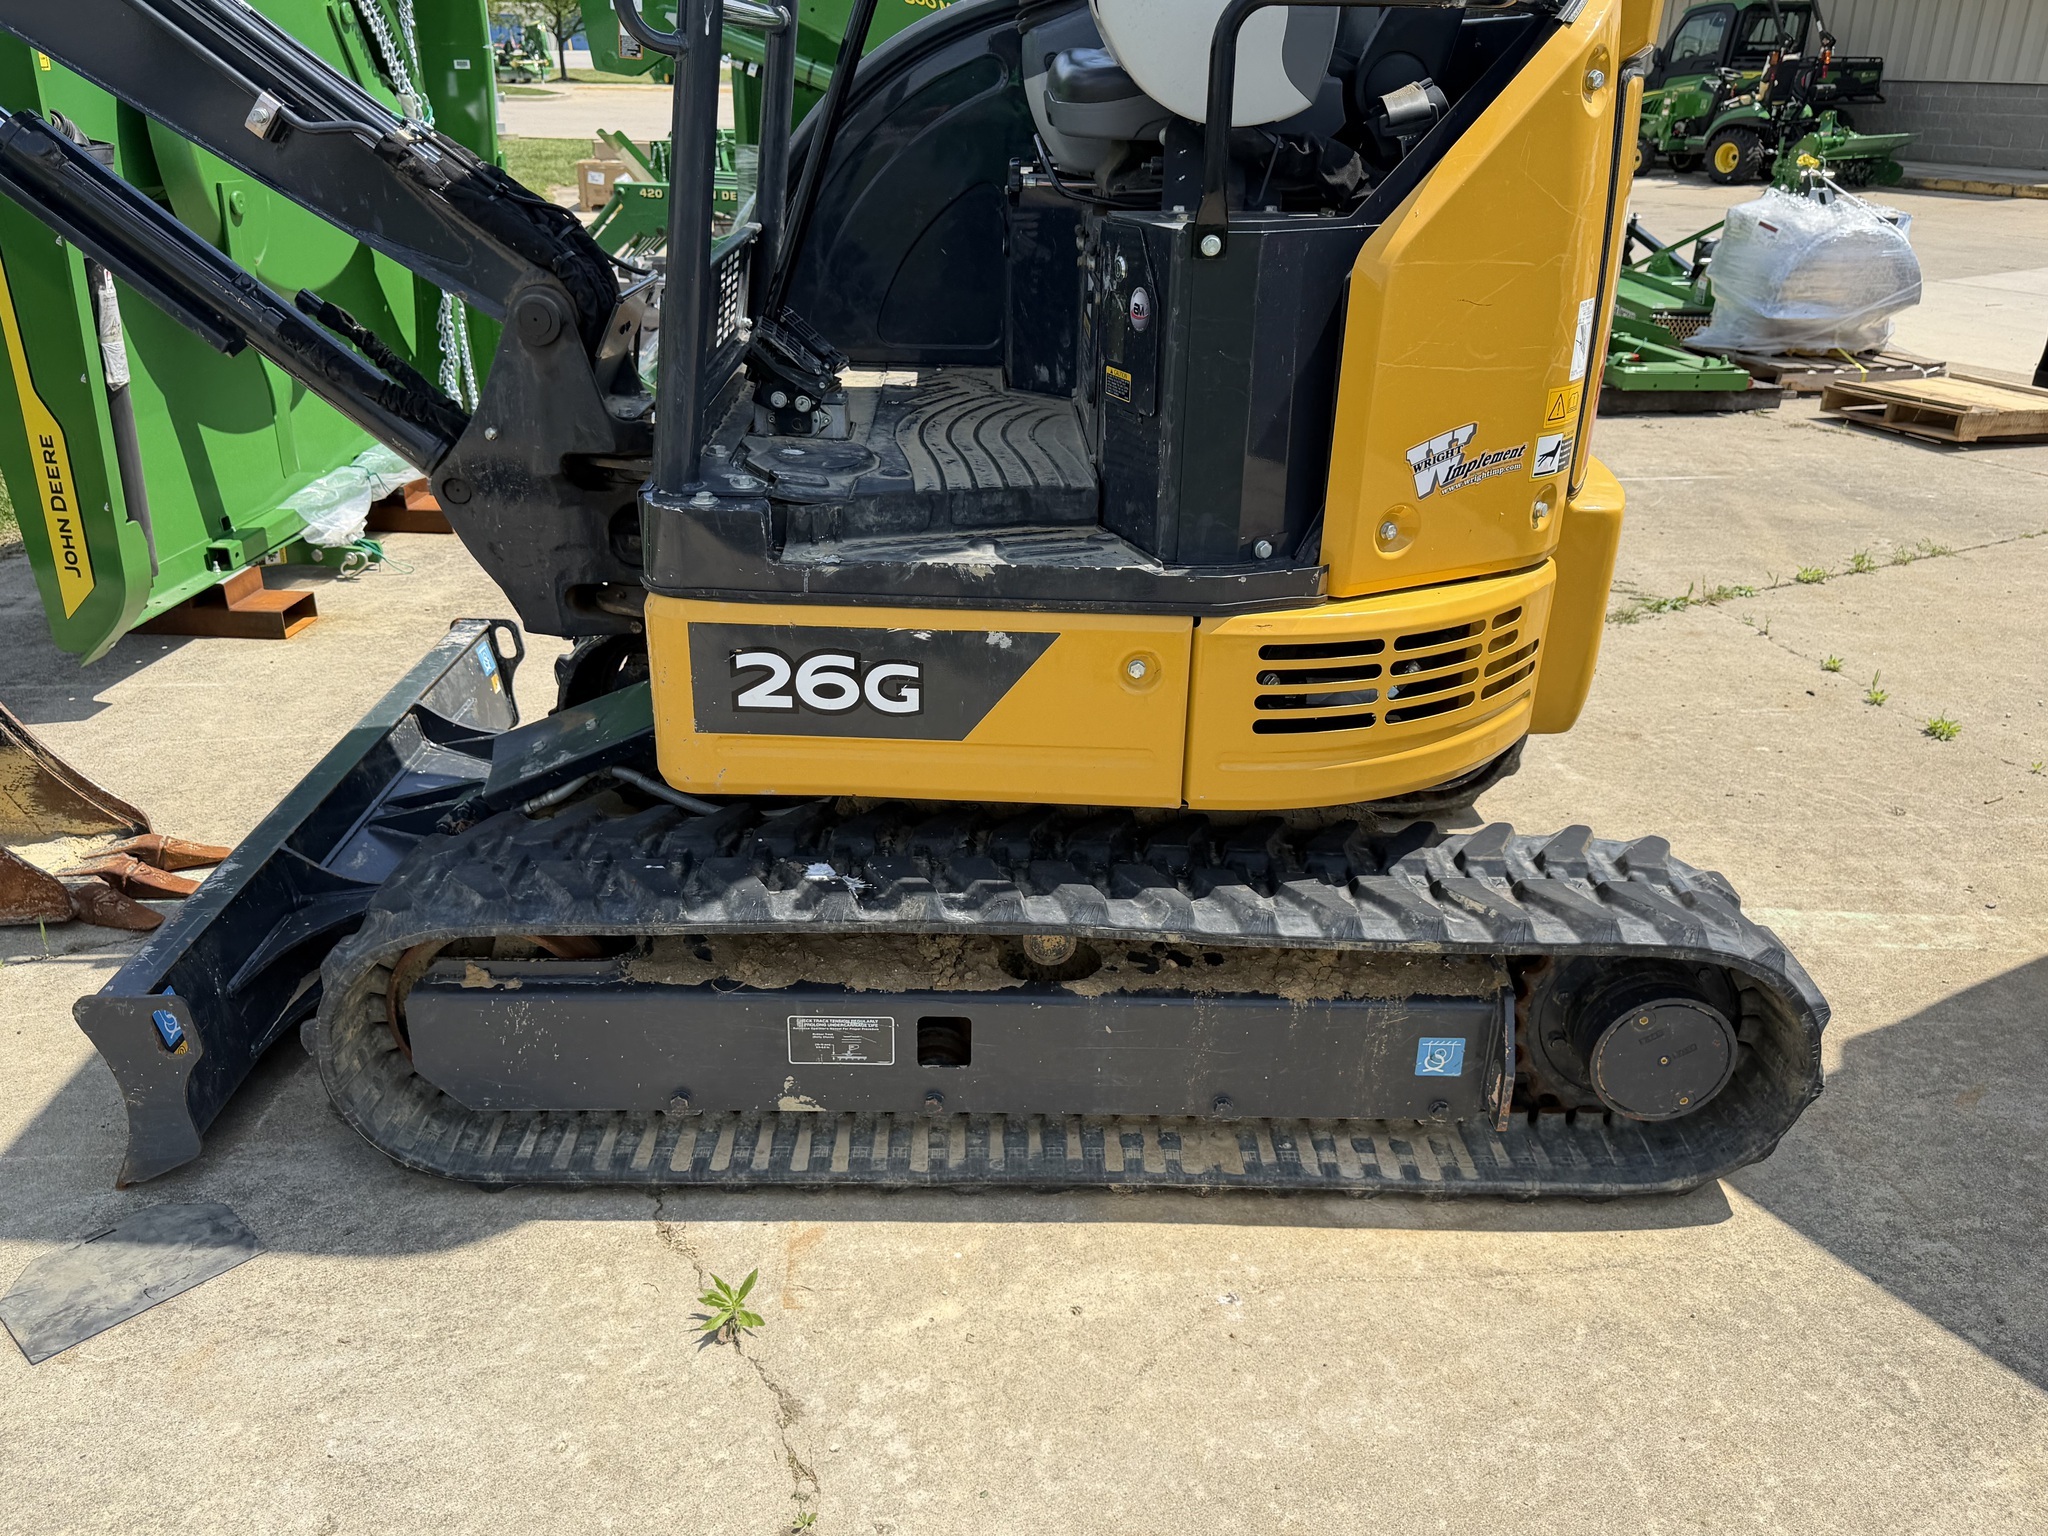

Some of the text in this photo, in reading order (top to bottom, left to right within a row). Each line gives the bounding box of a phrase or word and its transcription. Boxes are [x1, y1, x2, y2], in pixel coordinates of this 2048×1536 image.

[639, 188, 664, 199] 420
[1413, 445, 1464, 474] WRIGHT
[1442, 444, 1526, 484] Implement
[1441, 463, 1521, 495] www.wrightimp.com
[39, 434, 82, 579] JOHN DEERE
[733, 649, 922, 715] 26G
